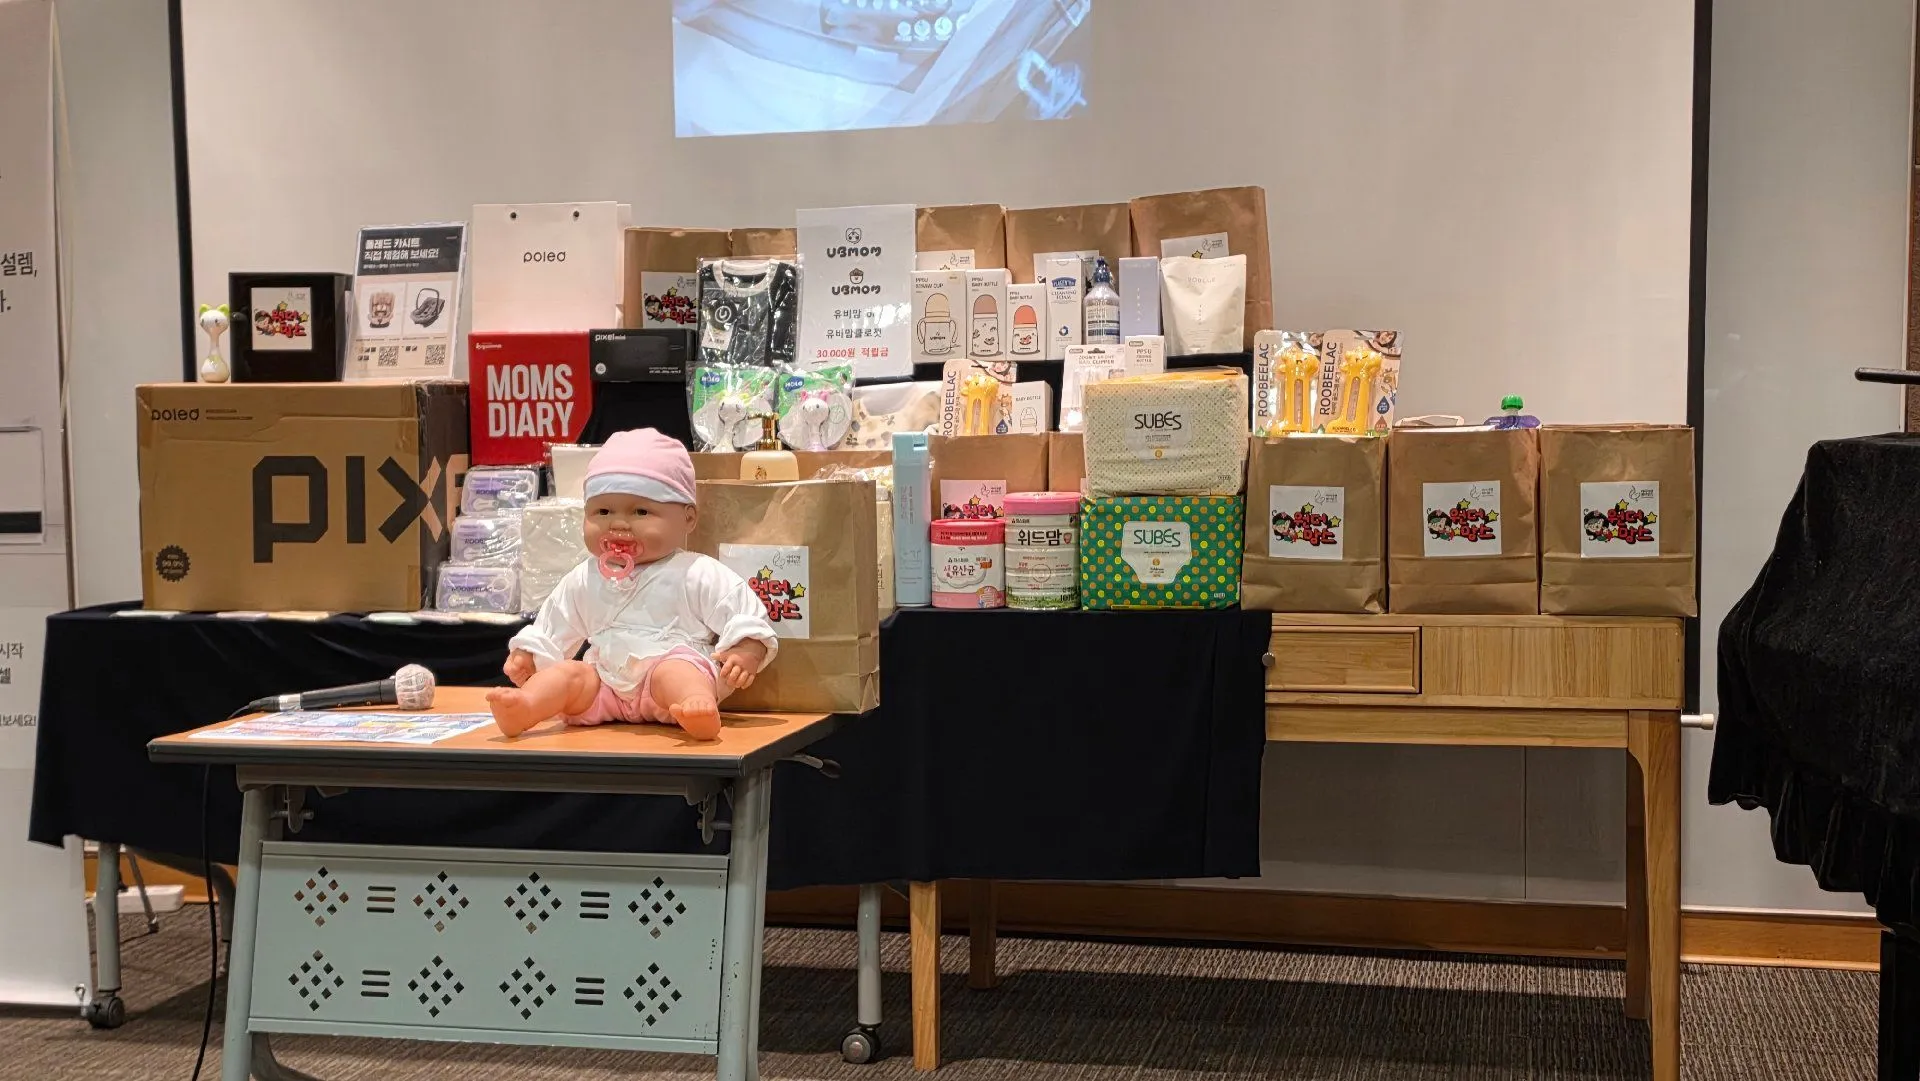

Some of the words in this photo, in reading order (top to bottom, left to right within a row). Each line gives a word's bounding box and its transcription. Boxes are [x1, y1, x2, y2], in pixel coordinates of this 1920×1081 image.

[523, 250, 566, 263] poled
[826, 245, 882, 258] UBMOM
[1, 252, 37, 277] 설렘,
[831, 284, 881, 296] UBMOM
[833, 308, 862, 320] 유비맘
[486, 363, 573, 401] MOMS
[1258, 343, 1269, 417] ROOBEELAC
[1319, 342, 1337, 415] ROOBEELAC
[488, 401, 574, 438] DIARY
[1134, 411, 1182, 430] SUBES
[1017, 528, 1062, 546] 위드맘
[1133, 528, 1181, 547] SUBES
